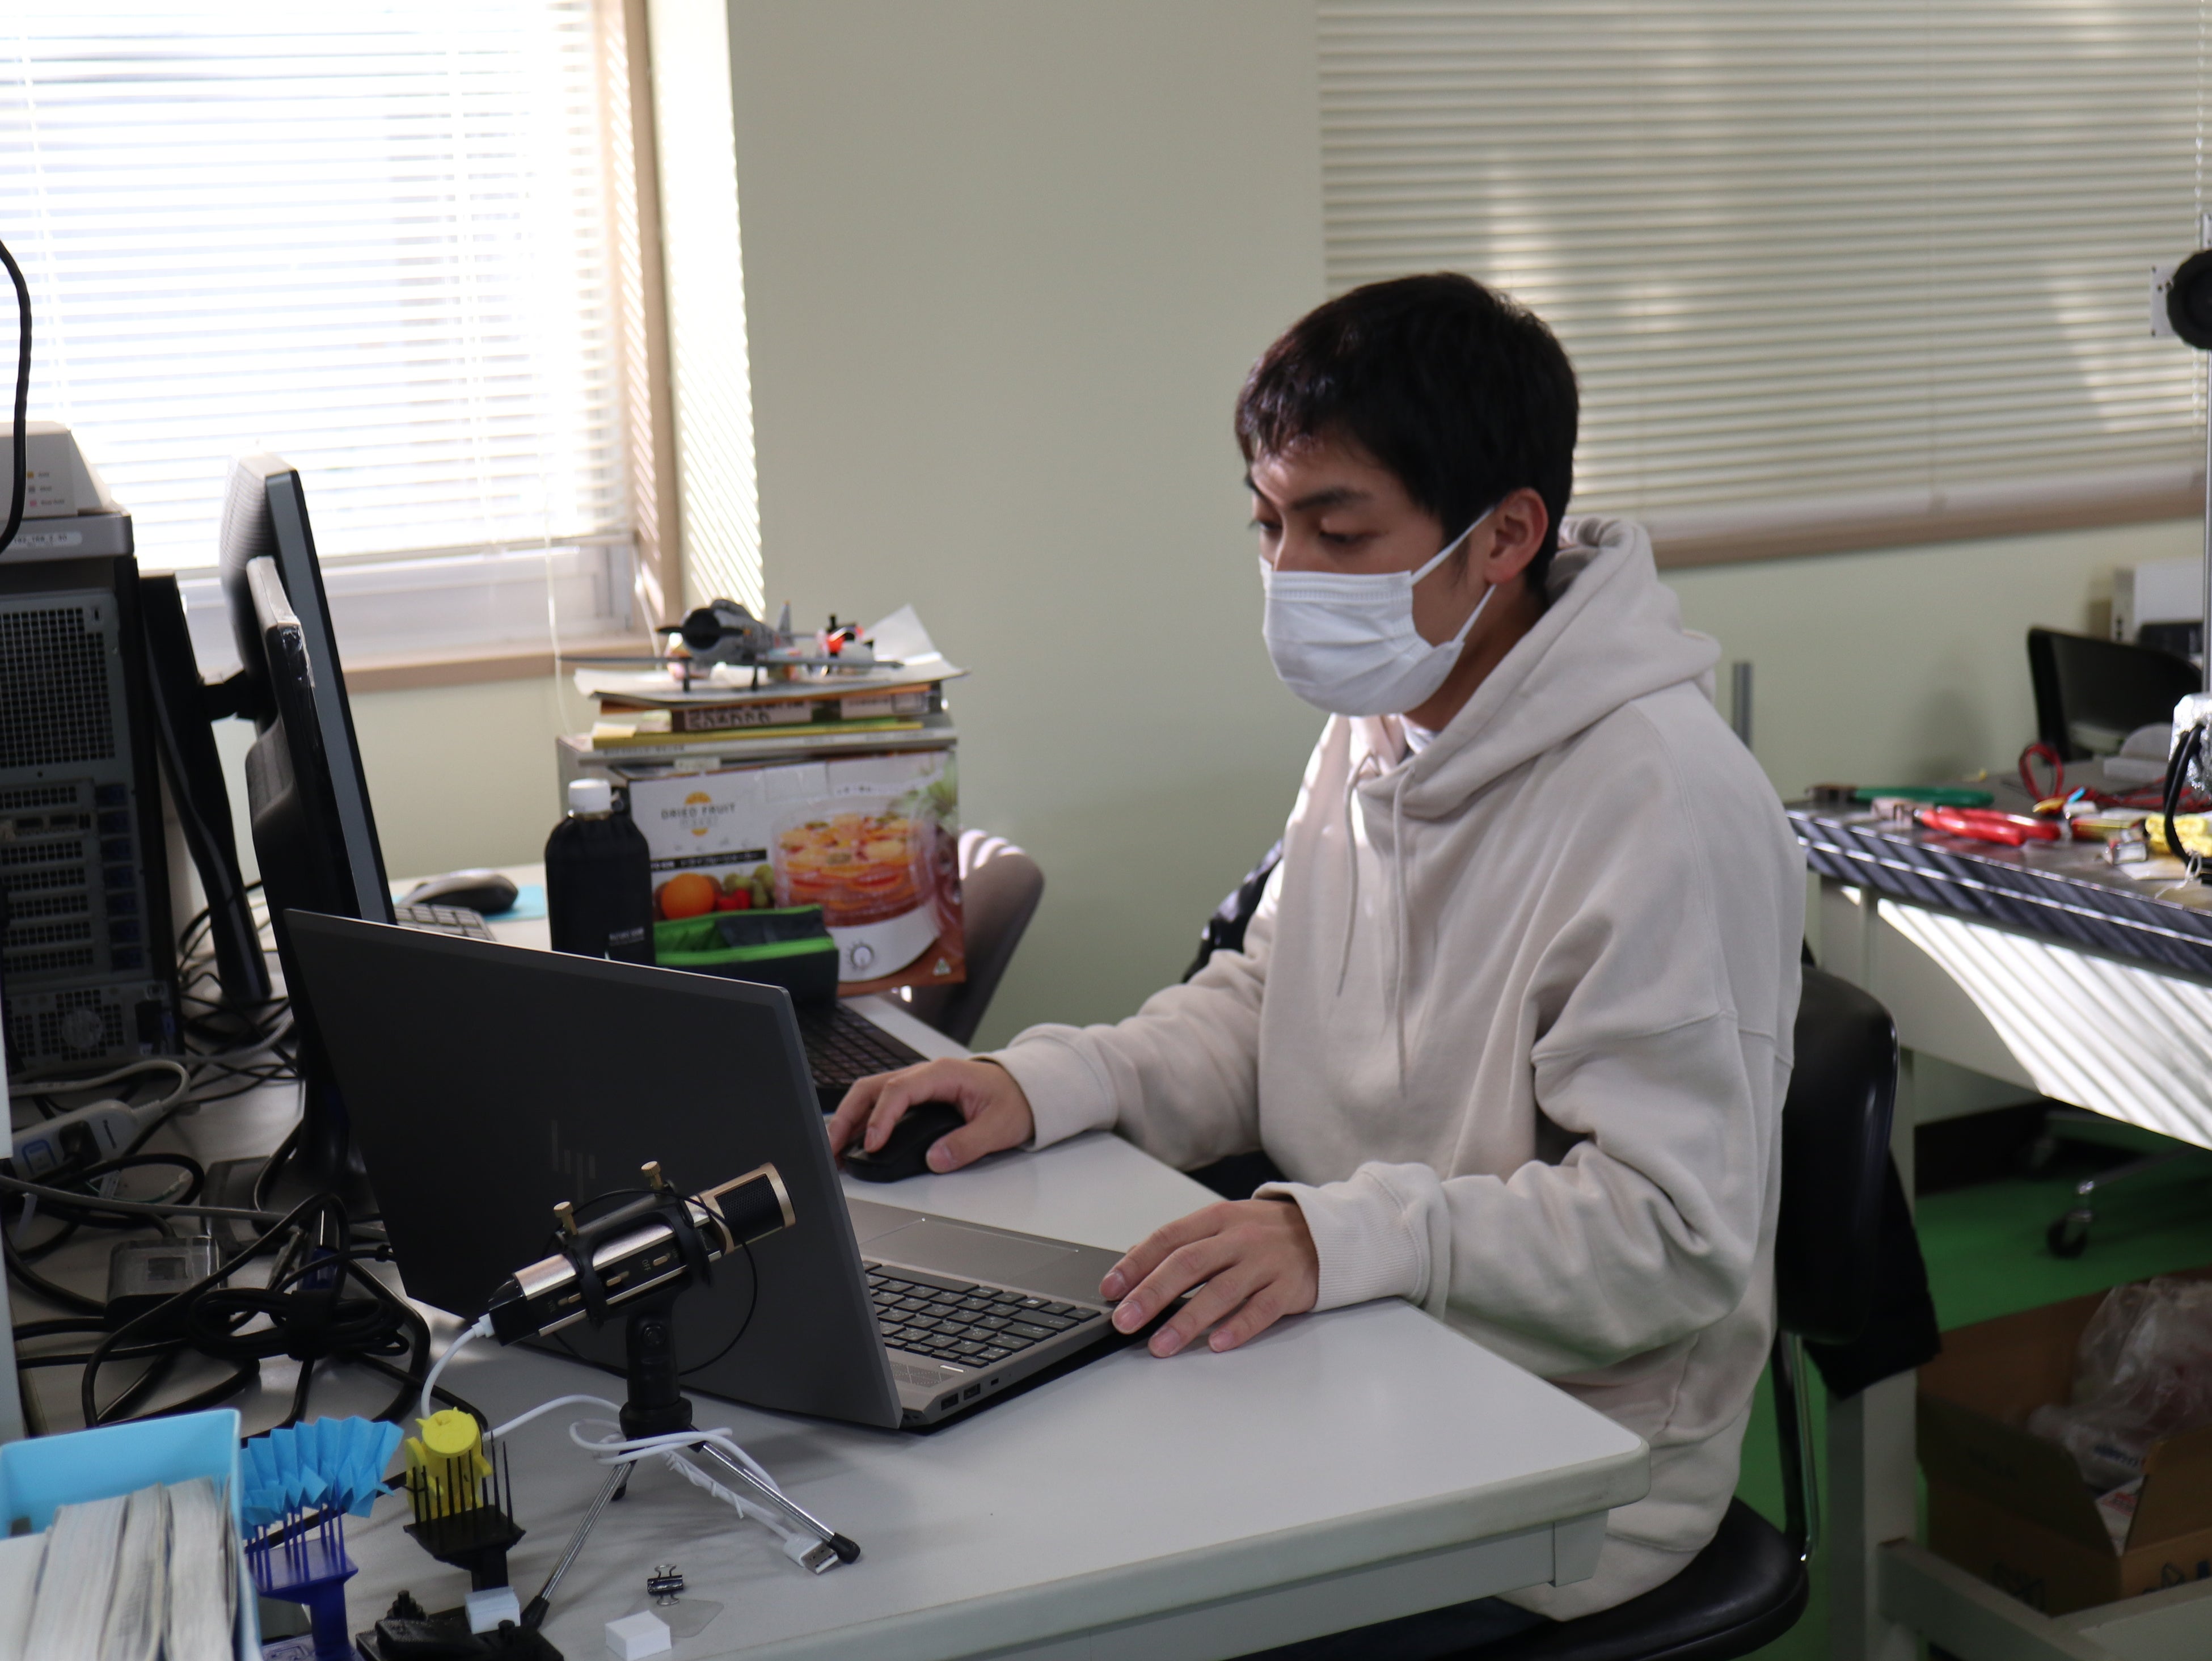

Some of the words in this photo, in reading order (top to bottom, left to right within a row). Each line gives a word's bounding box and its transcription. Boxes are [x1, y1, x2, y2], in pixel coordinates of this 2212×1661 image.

[661, 808, 697, 820] DRIED
[702, 803, 736, 814] FRUIT
[641, 1259, 652, 1271] OFF
